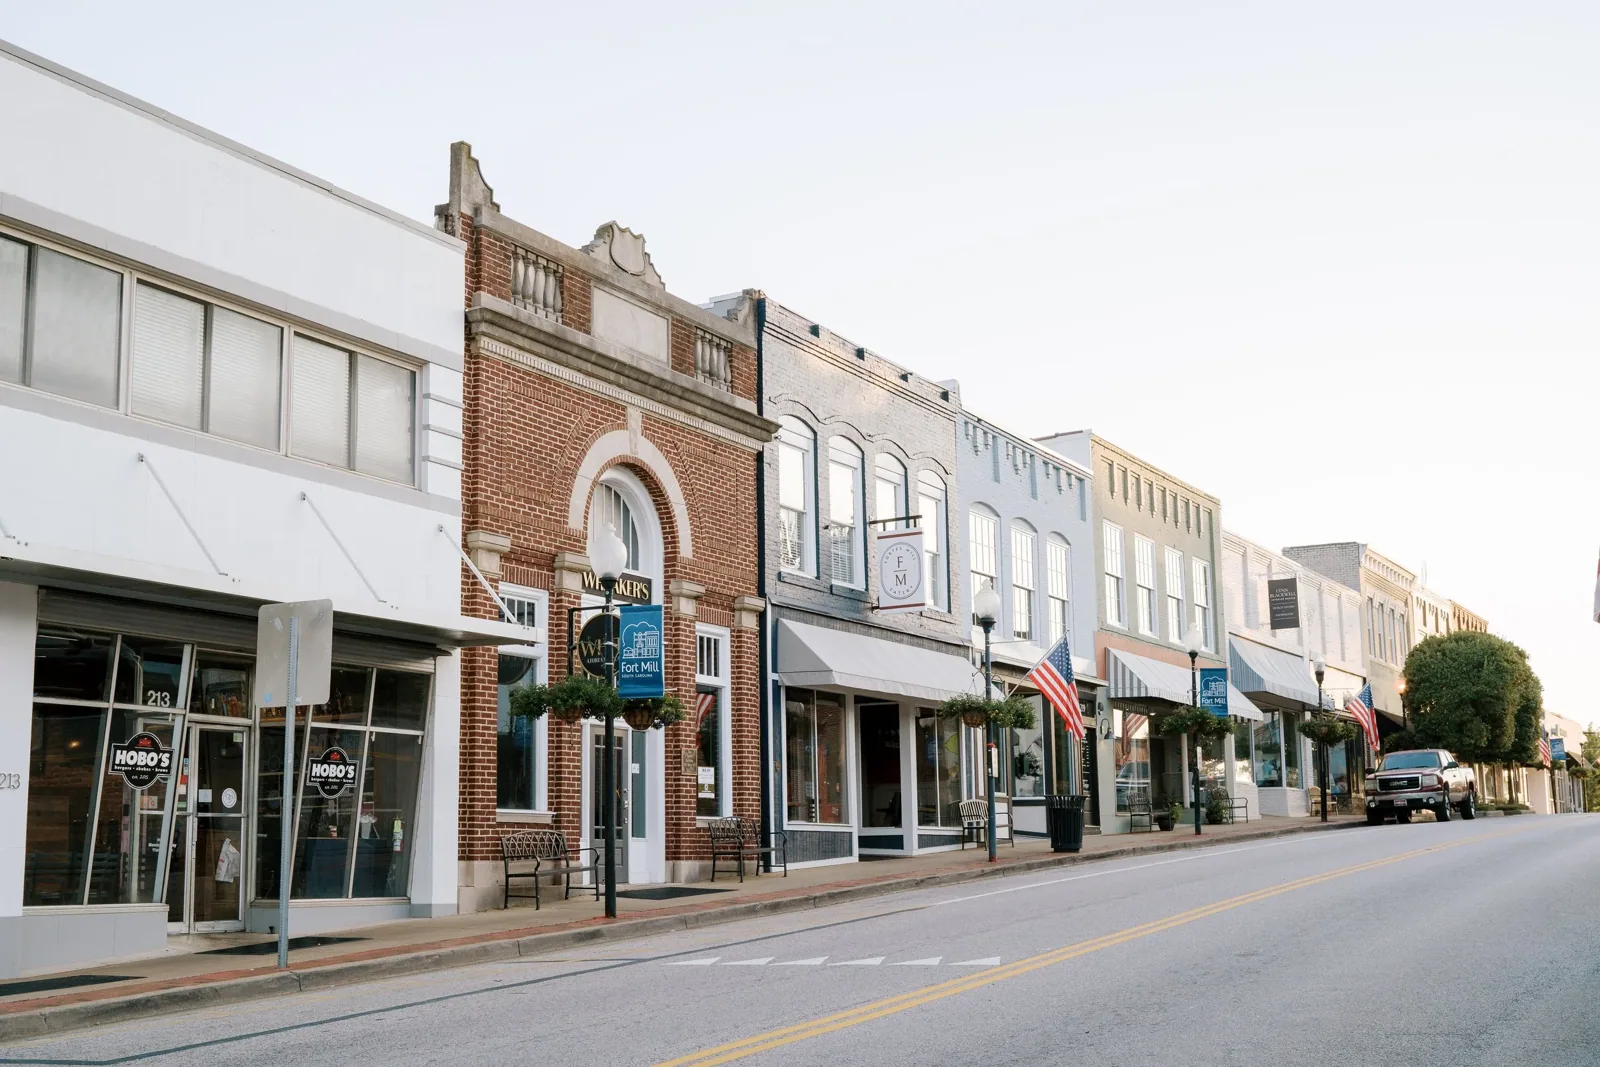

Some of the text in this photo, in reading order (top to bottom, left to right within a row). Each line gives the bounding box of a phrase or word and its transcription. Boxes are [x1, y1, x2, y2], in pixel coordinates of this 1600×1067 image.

[897, 555, 904, 569] F
[582, 571, 649, 601] WHAKER'S
[895, 573, 907, 587] M
[621, 661, 660, 673] Fort Mill
[147, 690, 170, 708] 213
[114, 749, 171, 768] HOBO'S
[311, 763, 355, 779] HOBO'S
[0, 772, 21, 790] 213
